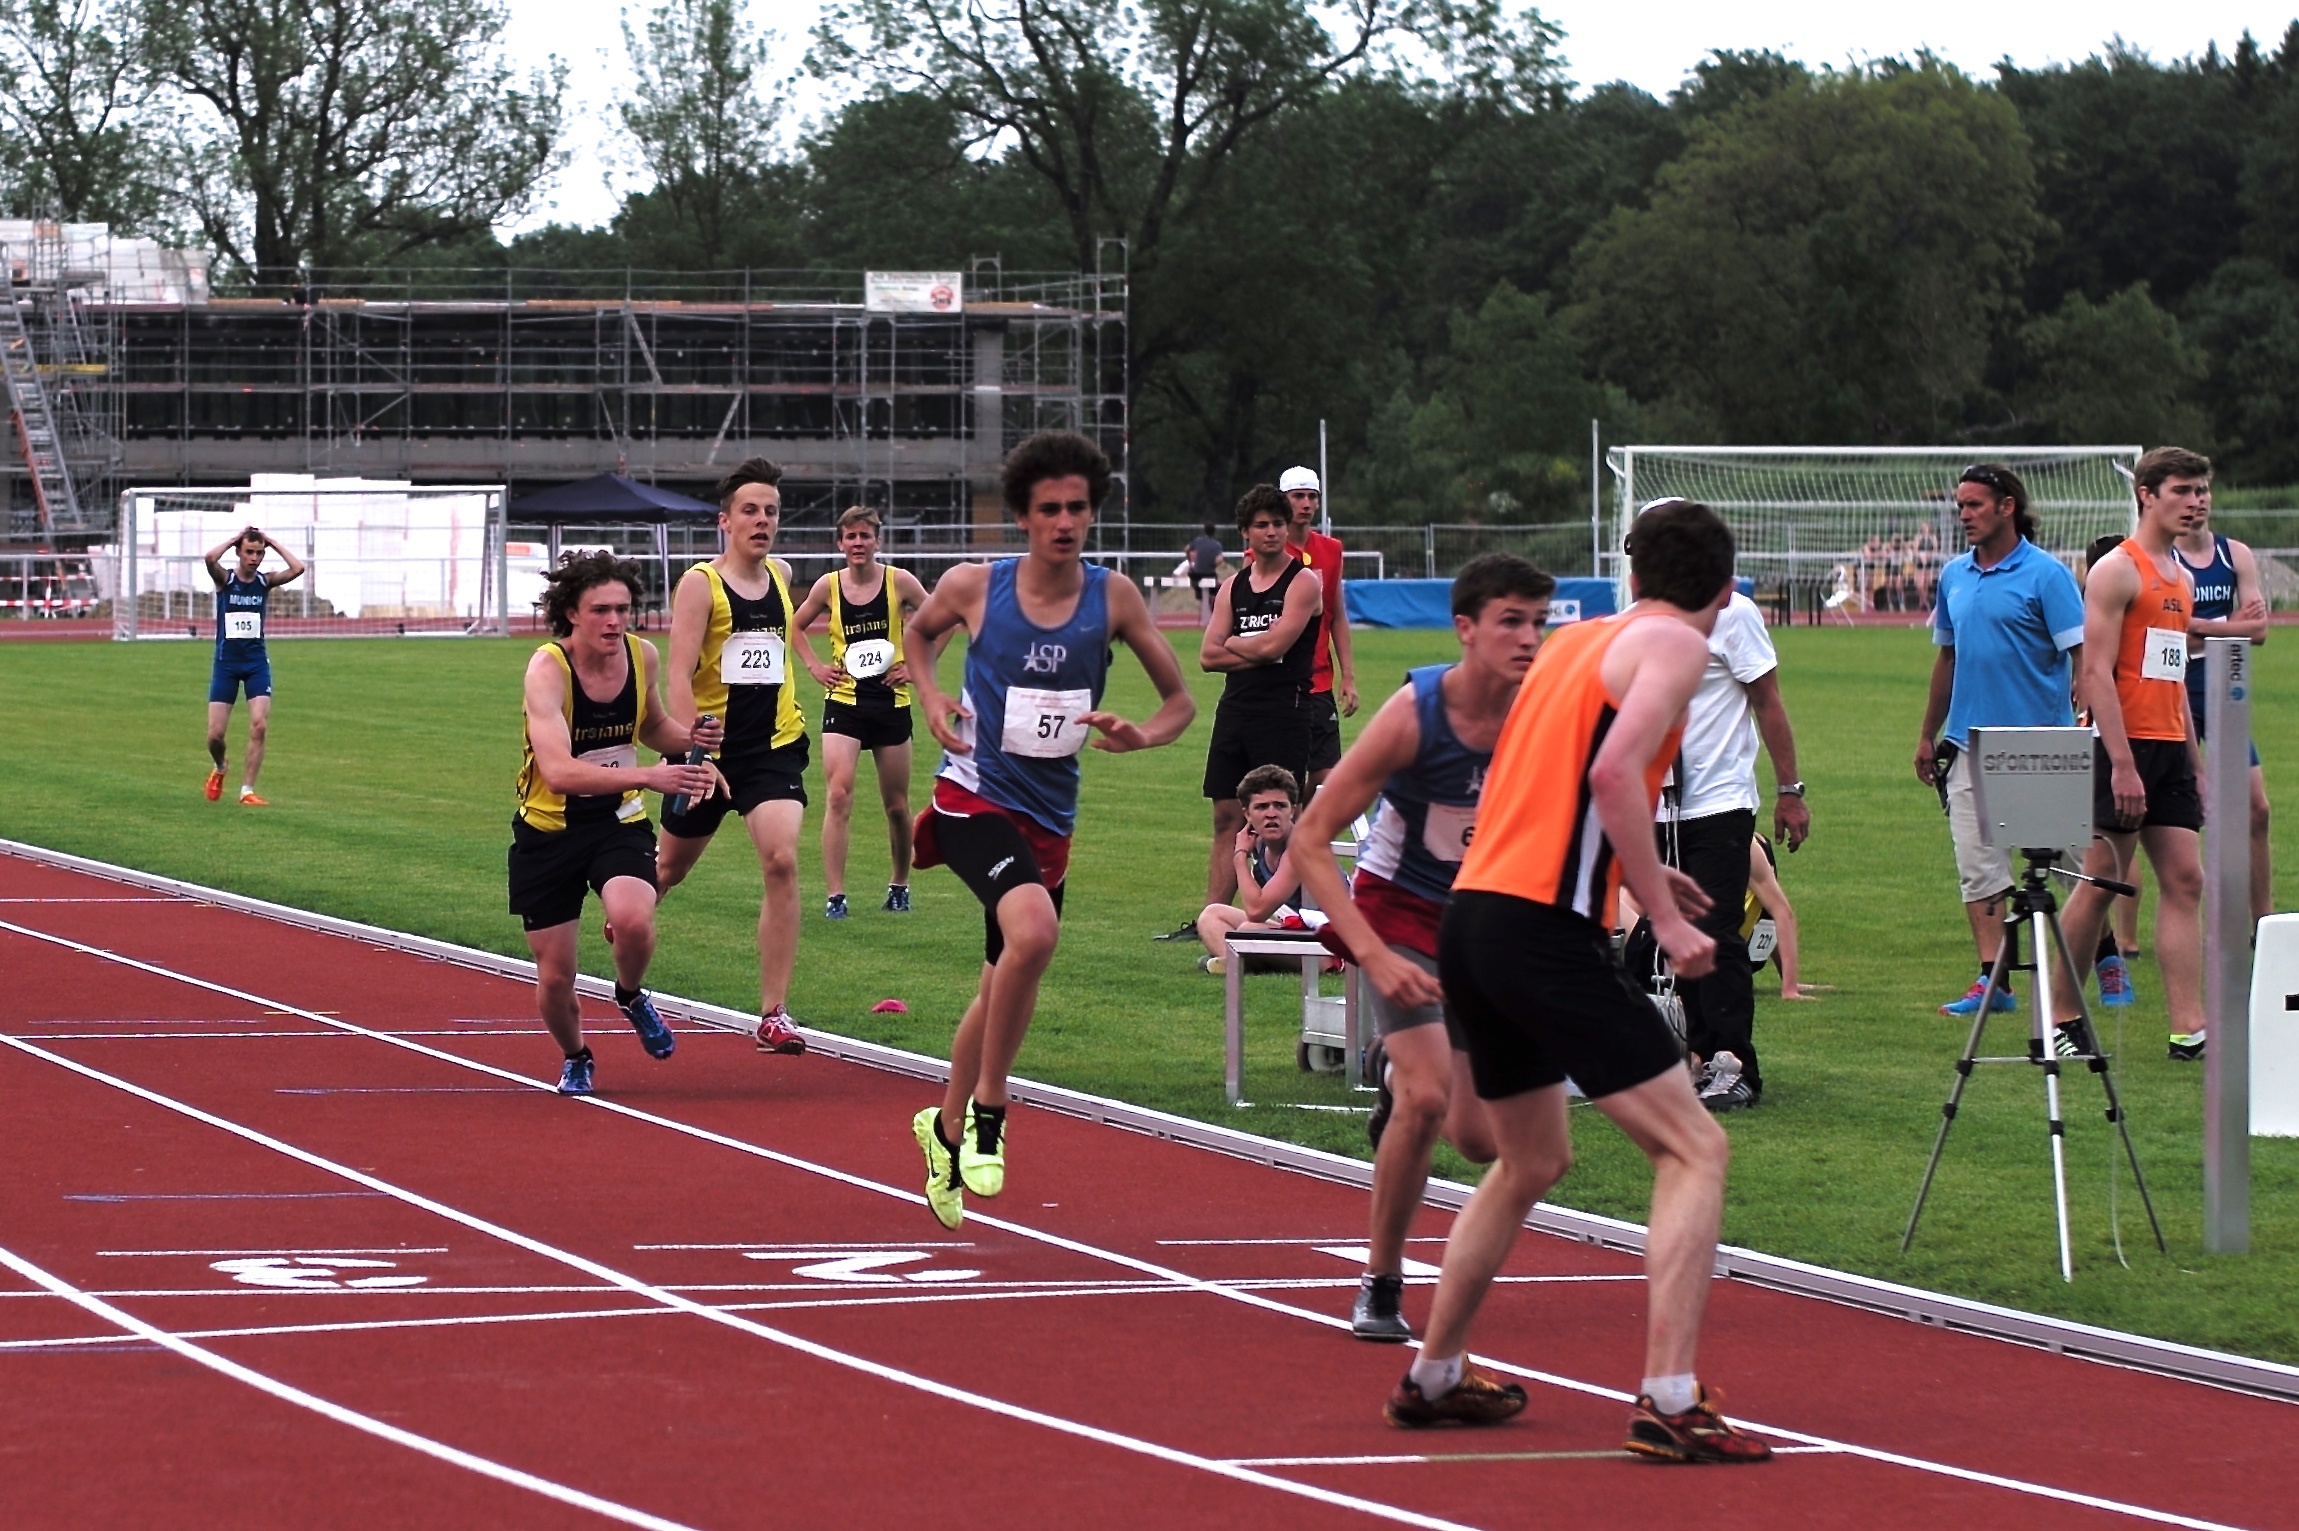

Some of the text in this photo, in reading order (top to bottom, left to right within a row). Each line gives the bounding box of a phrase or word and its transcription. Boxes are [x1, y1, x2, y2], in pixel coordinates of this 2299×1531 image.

[229, 594, 263, 606] MUNICH
[2194, 585, 2231, 602] UNICH
[235, 620, 252, 631] 105
[844, 619, 888, 636] trojans
[1240, 613, 1279, 630] ZRICH
[741, 649, 771, 669] 223
[858, 650, 883, 668] 224
[1023, 641, 1067, 673] ASP
[2161, 647, 2181, 668] 188
[574, 719, 635, 742] trojans
[1037, 714, 1067, 739] 57
[1984, 751, 2091, 771] SPORTRONIC
[1460, 825, 1476, 847] 6
